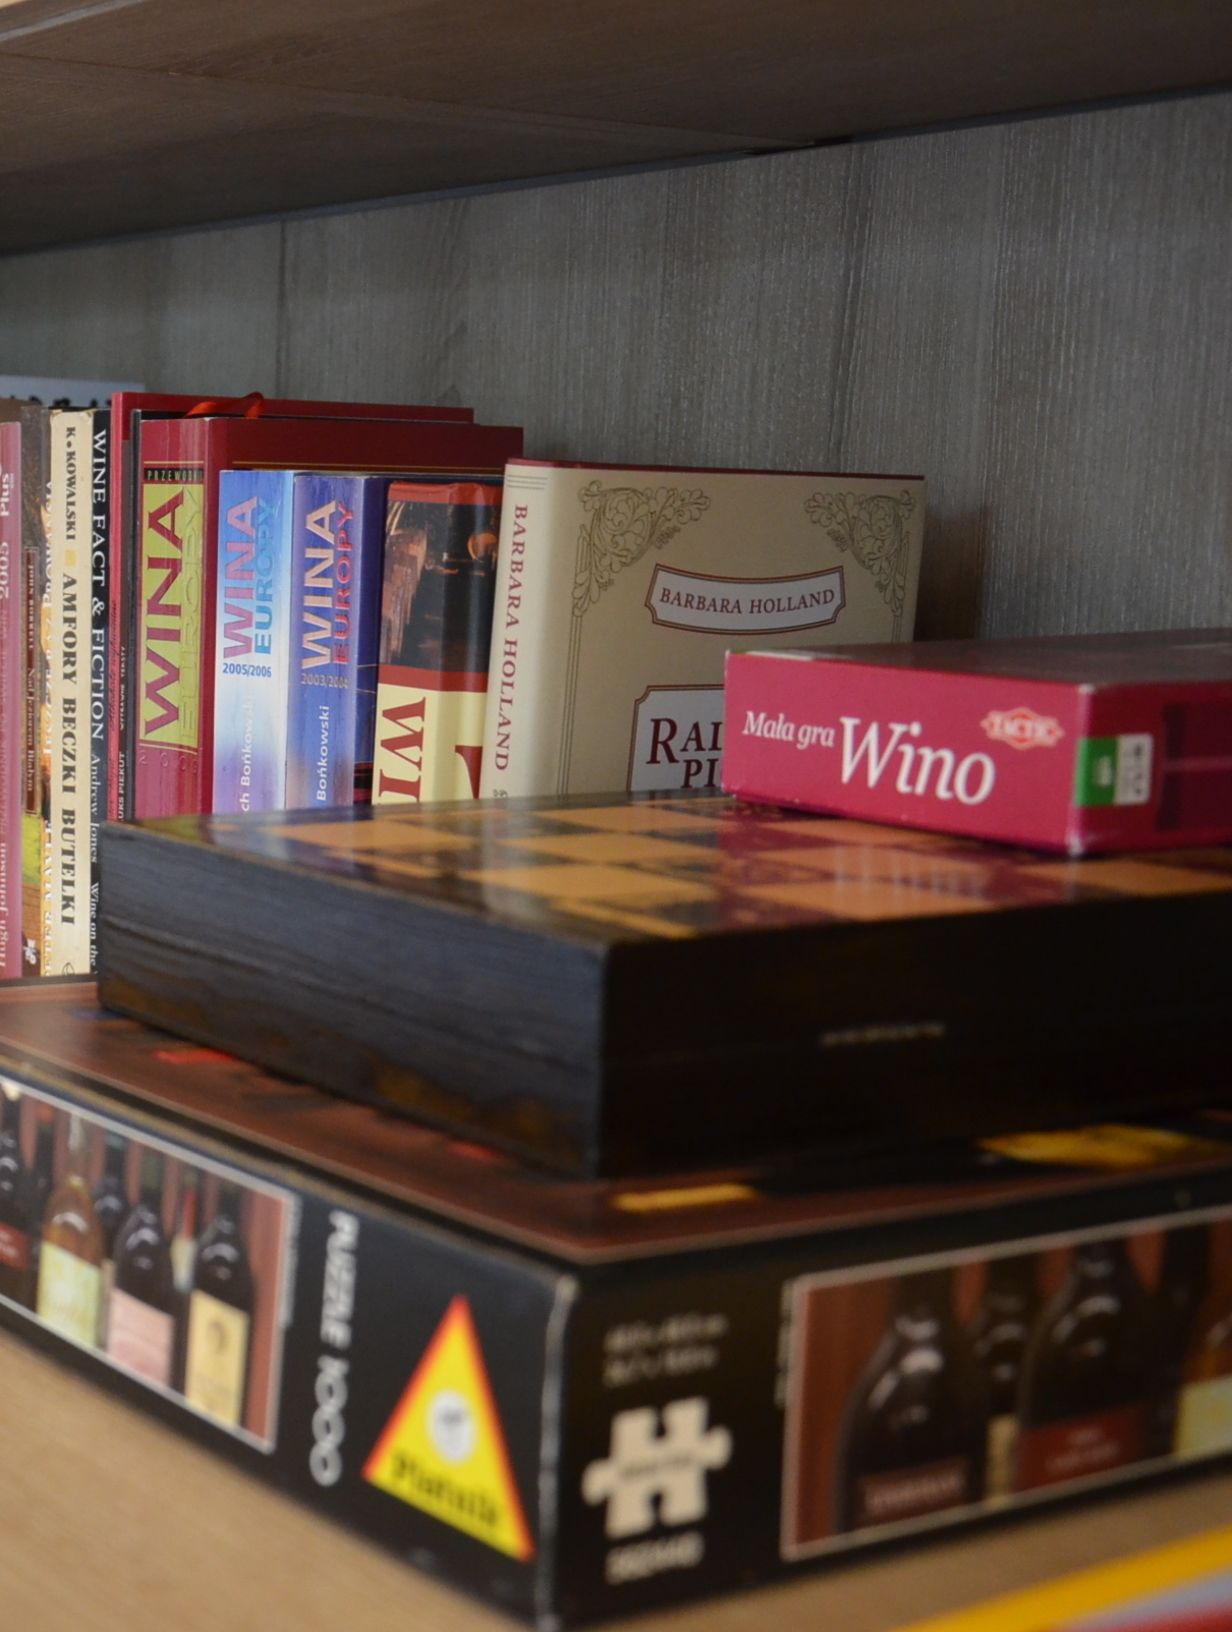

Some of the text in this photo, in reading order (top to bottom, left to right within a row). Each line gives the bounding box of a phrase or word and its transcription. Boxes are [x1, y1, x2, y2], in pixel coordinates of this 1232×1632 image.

[0, 473, 10, 517] Plus
[65, 451, 77, 540] KOWALSKI
[92, 429, 107, 503] WINE
[92, 515, 106, 587] FACT
[223, 496, 276, 659] WINA EUROPY
[301, 500, 356, 670] WINA EUROPY
[62, 574, 78, 685] AMFORY
[92, 597, 105, 616] &
[144, 487, 184, 737] WINA
[495, 504, 528, 771] BARBARA HOLLAND
[659, 587, 835, 614] BARBARA HOLLAND
[91, 628, 105, 740] FICTION
[222, 662, 272, 678] 2005/2006
[61, 697, 77, 793] BECZKI
[90, 754, 102, 816] Andrew
[316, 705, 331, 801] Bońkowski
[742, 711, 996, 805] Mała gra Wino
[60, 809, 76, 925] BUTELKI
